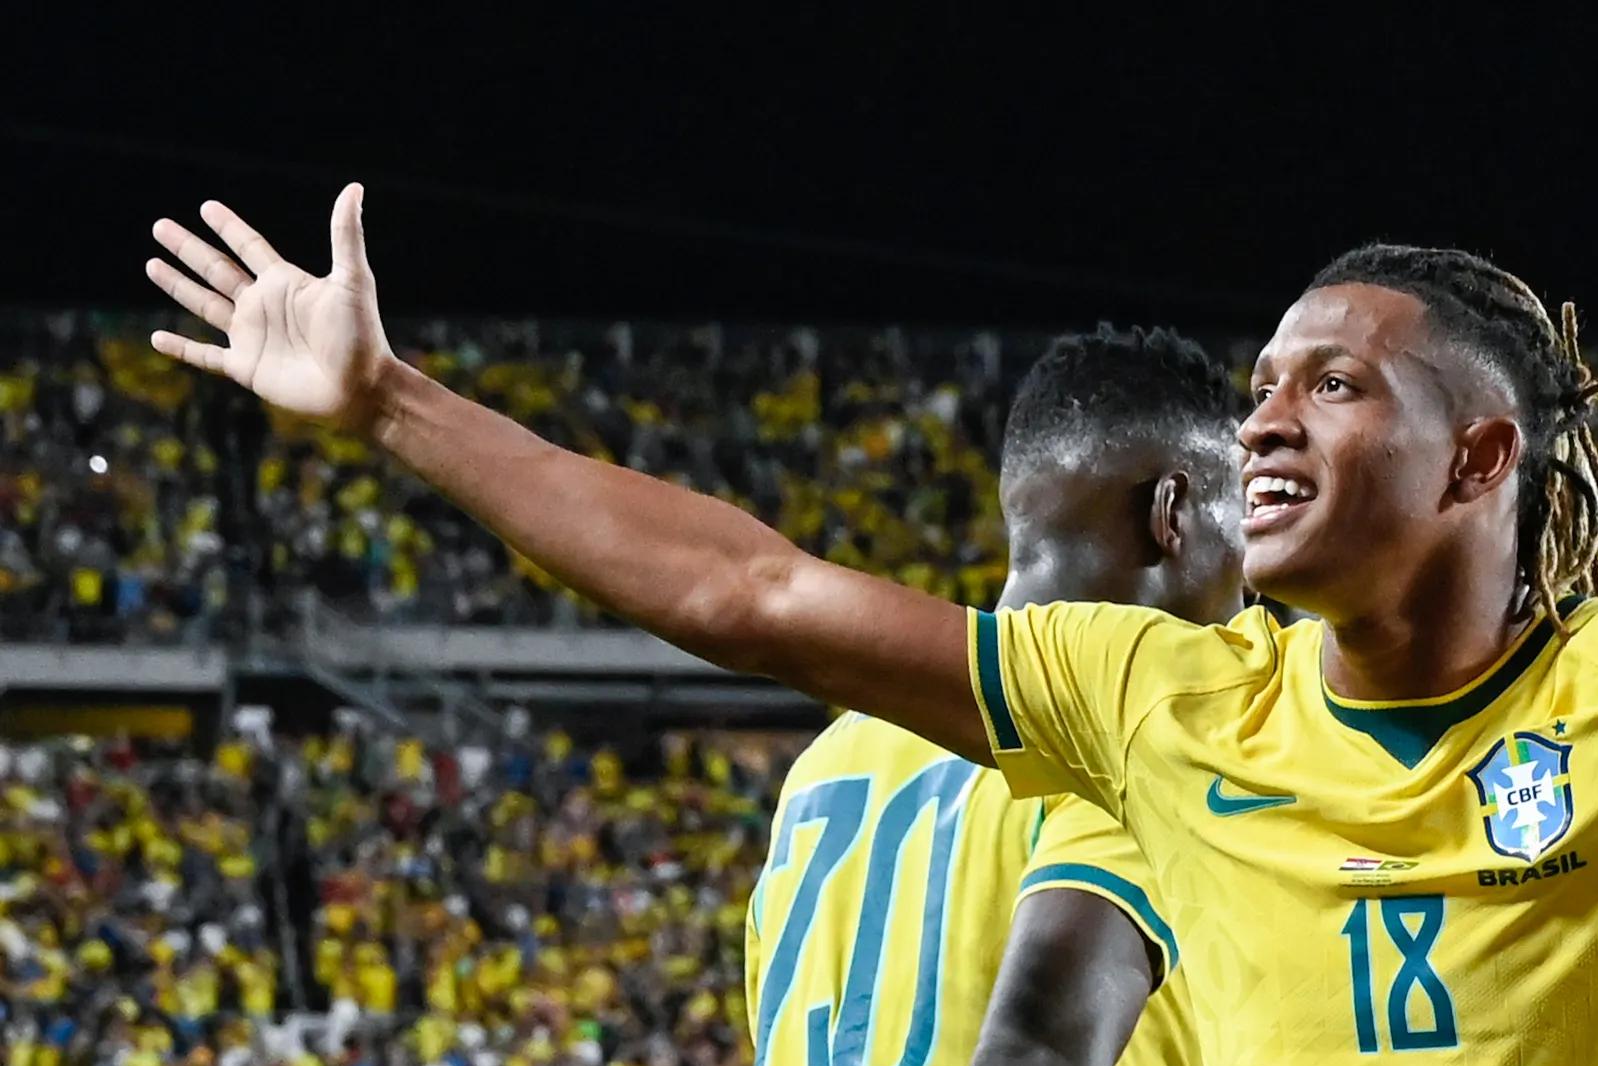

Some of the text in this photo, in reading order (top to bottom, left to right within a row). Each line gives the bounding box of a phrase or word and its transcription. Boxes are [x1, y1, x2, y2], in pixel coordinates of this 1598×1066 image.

[1506, 783, 1543, 806] CBF
[1477, 850, 1588, 887] BRASIL
[1339, 892, 1460, 1055] 18
